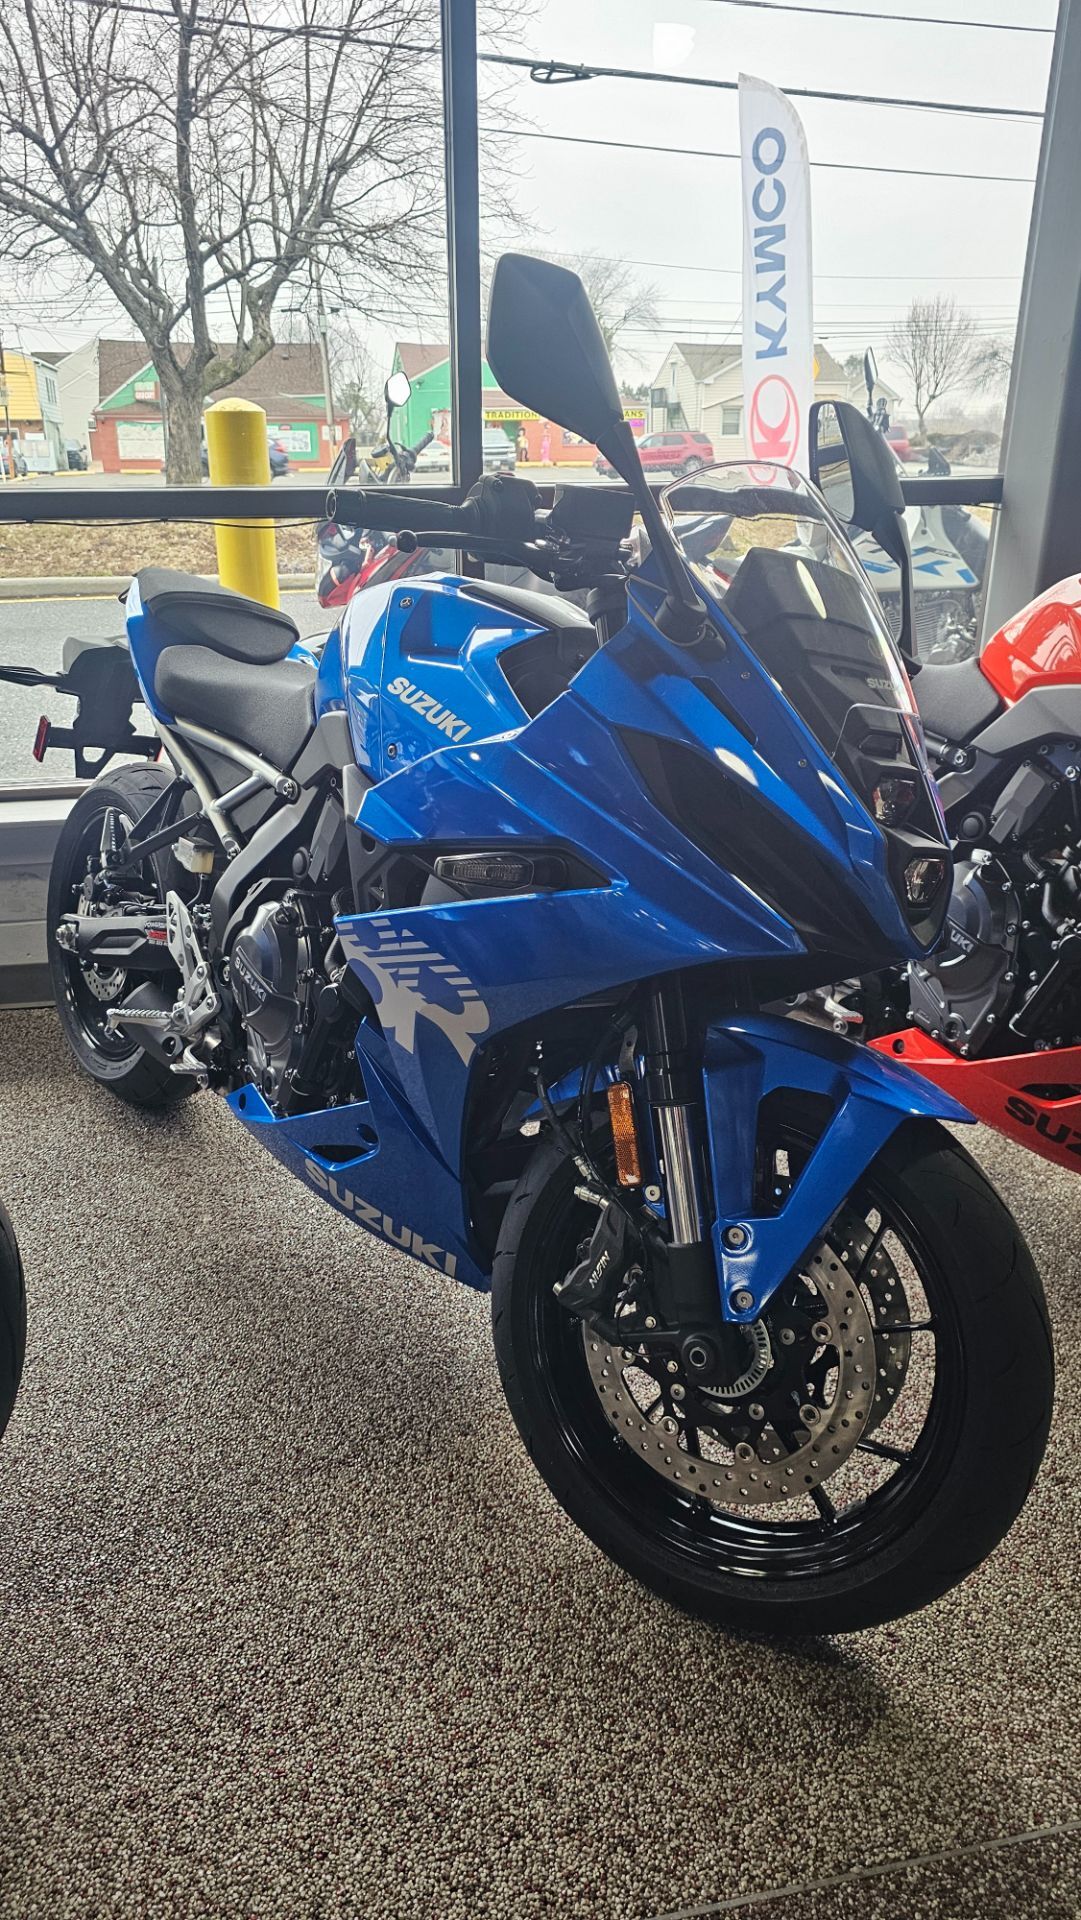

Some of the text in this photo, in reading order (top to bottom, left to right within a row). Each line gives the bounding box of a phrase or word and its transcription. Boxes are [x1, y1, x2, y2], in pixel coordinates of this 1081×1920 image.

[387, 676, 472, 742] SUZUKI
[234, 956, 267, 1002] SUZUKI
[304, 1158, 457, 1277] SUZUKI
